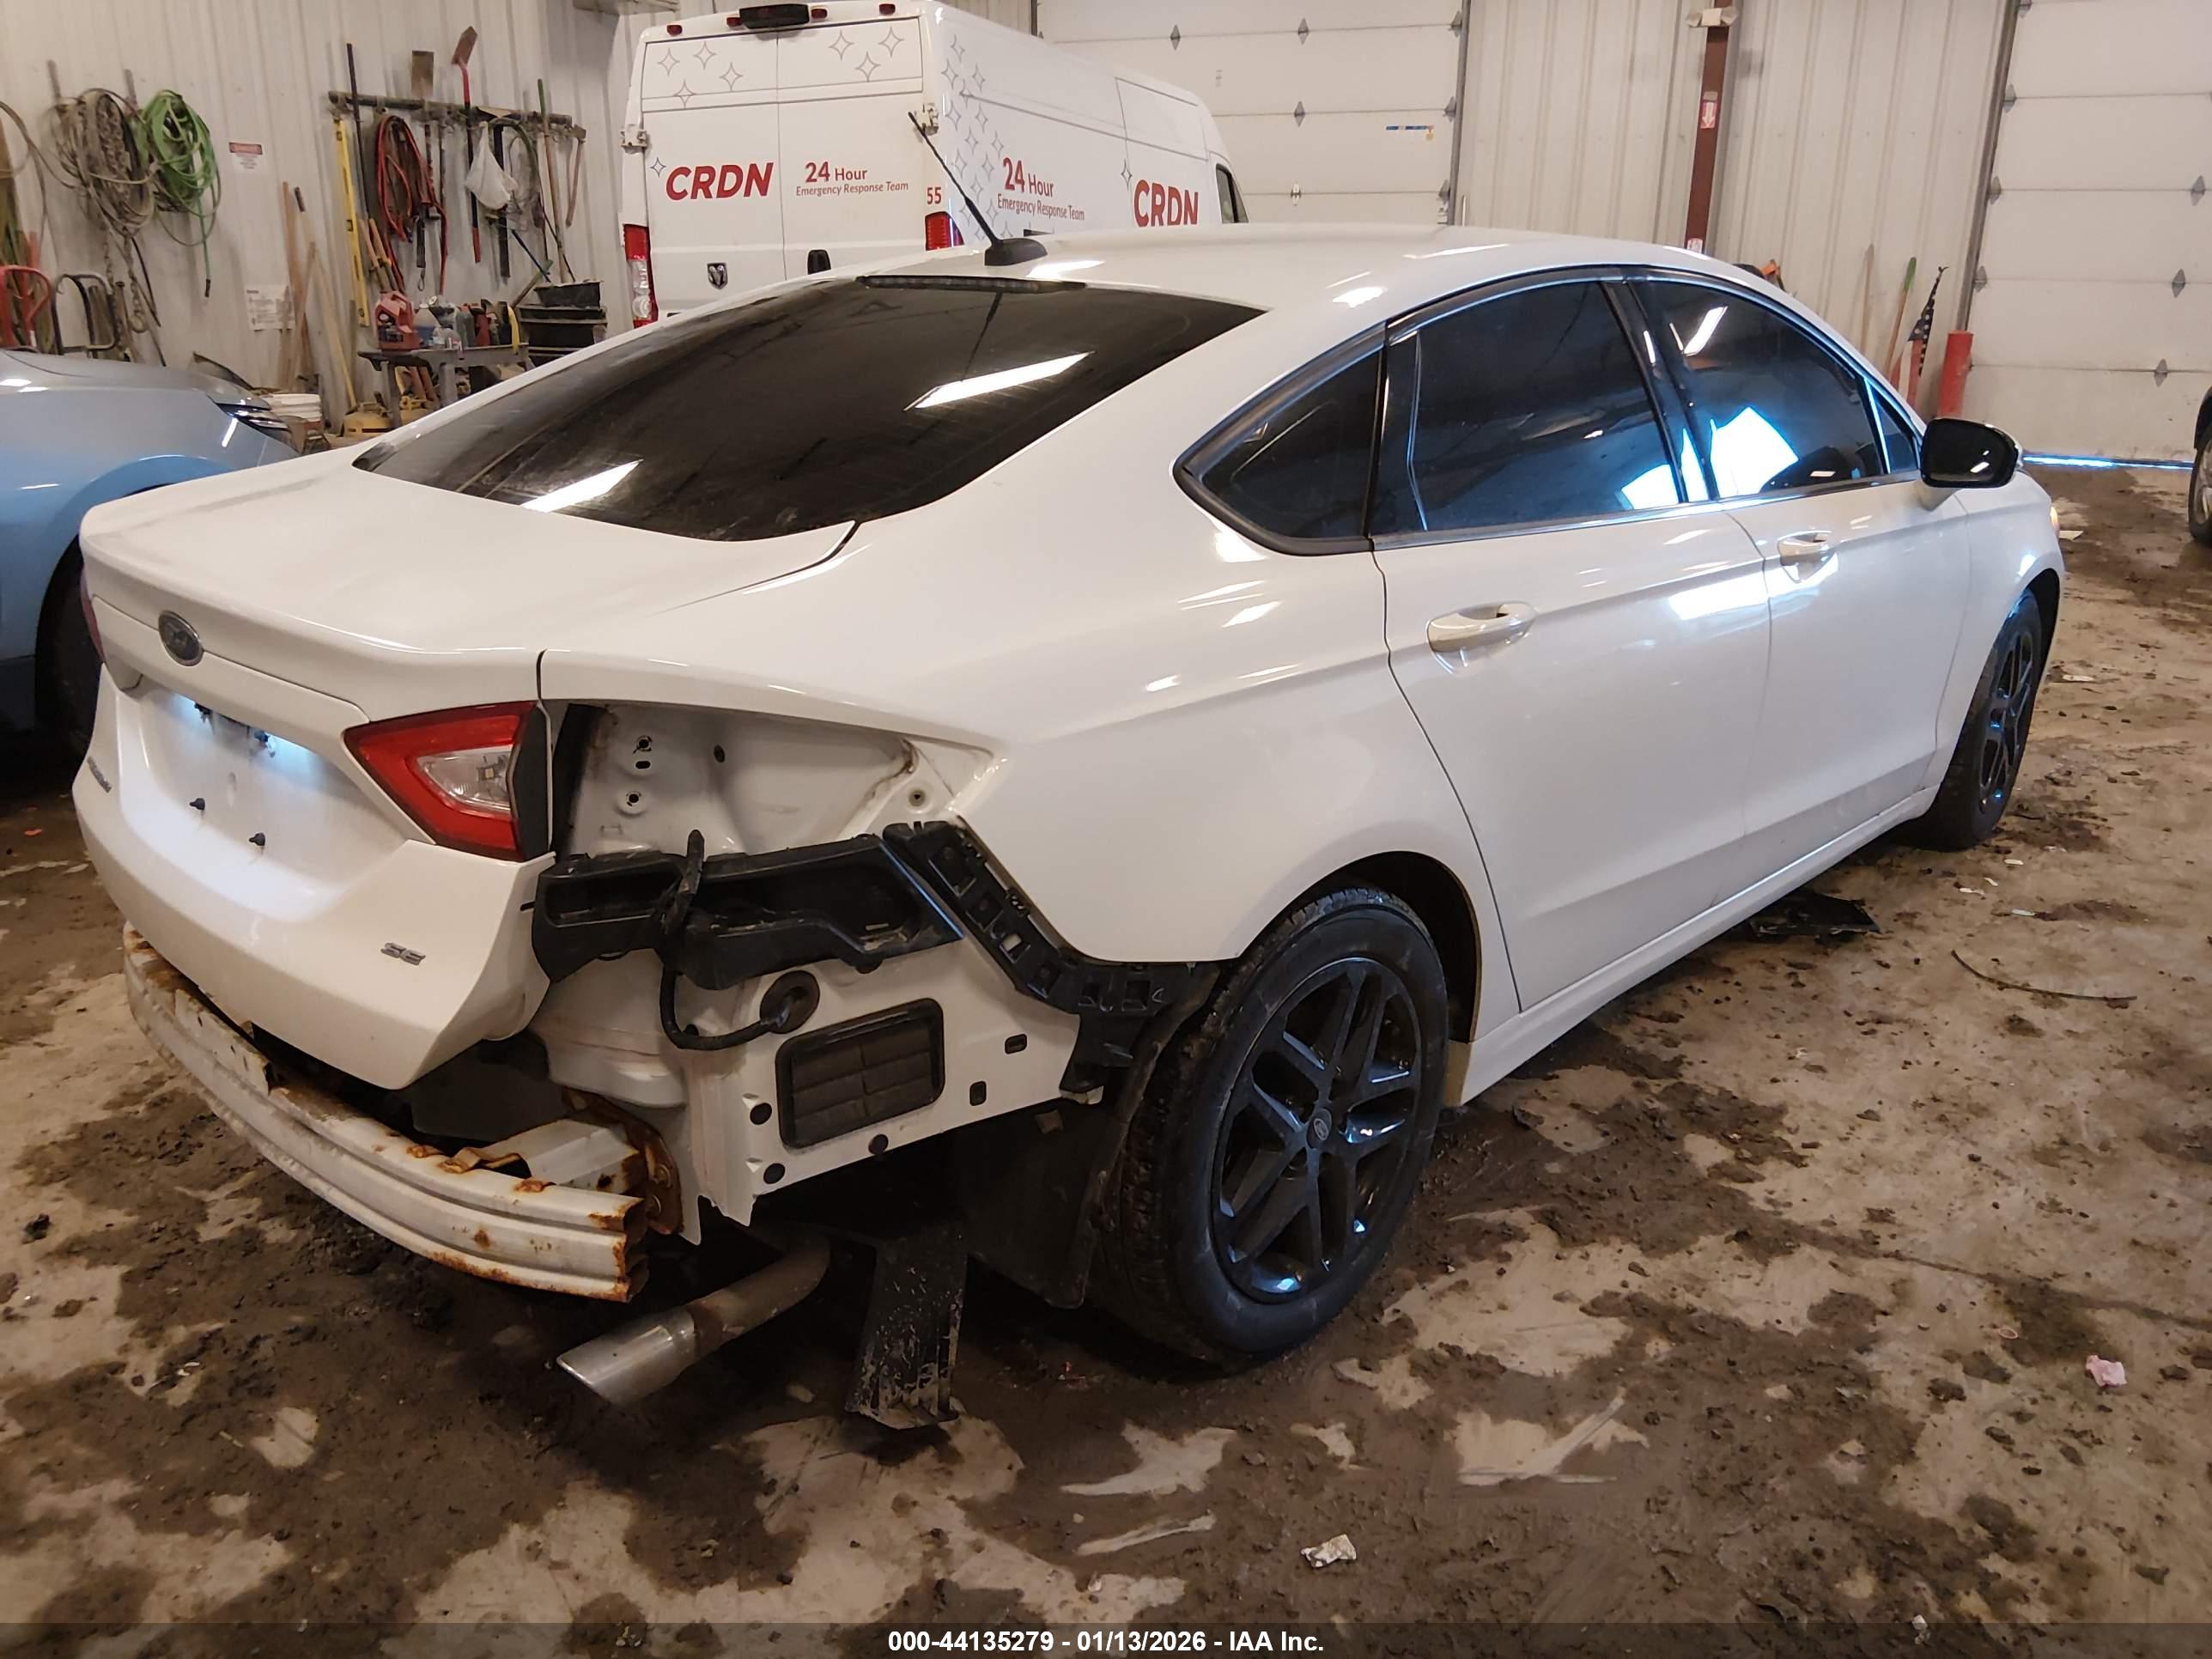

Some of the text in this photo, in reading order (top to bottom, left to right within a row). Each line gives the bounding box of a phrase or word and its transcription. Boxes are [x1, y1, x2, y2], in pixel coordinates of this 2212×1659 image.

[665, 162, 774, 201] CRDN
[805, 161, 867, 183] 24 Hour
[1003, 157, 1054, 198] 24 Hour
[796, 181, 909, 197] Emergency Response Team
[927, 186, 942, 205] 55
[998, 193, 1085, 221] Emergency Response Team
[1133, 179, 1199, 228] CRDN
[380, 943, 426, 965] SE
